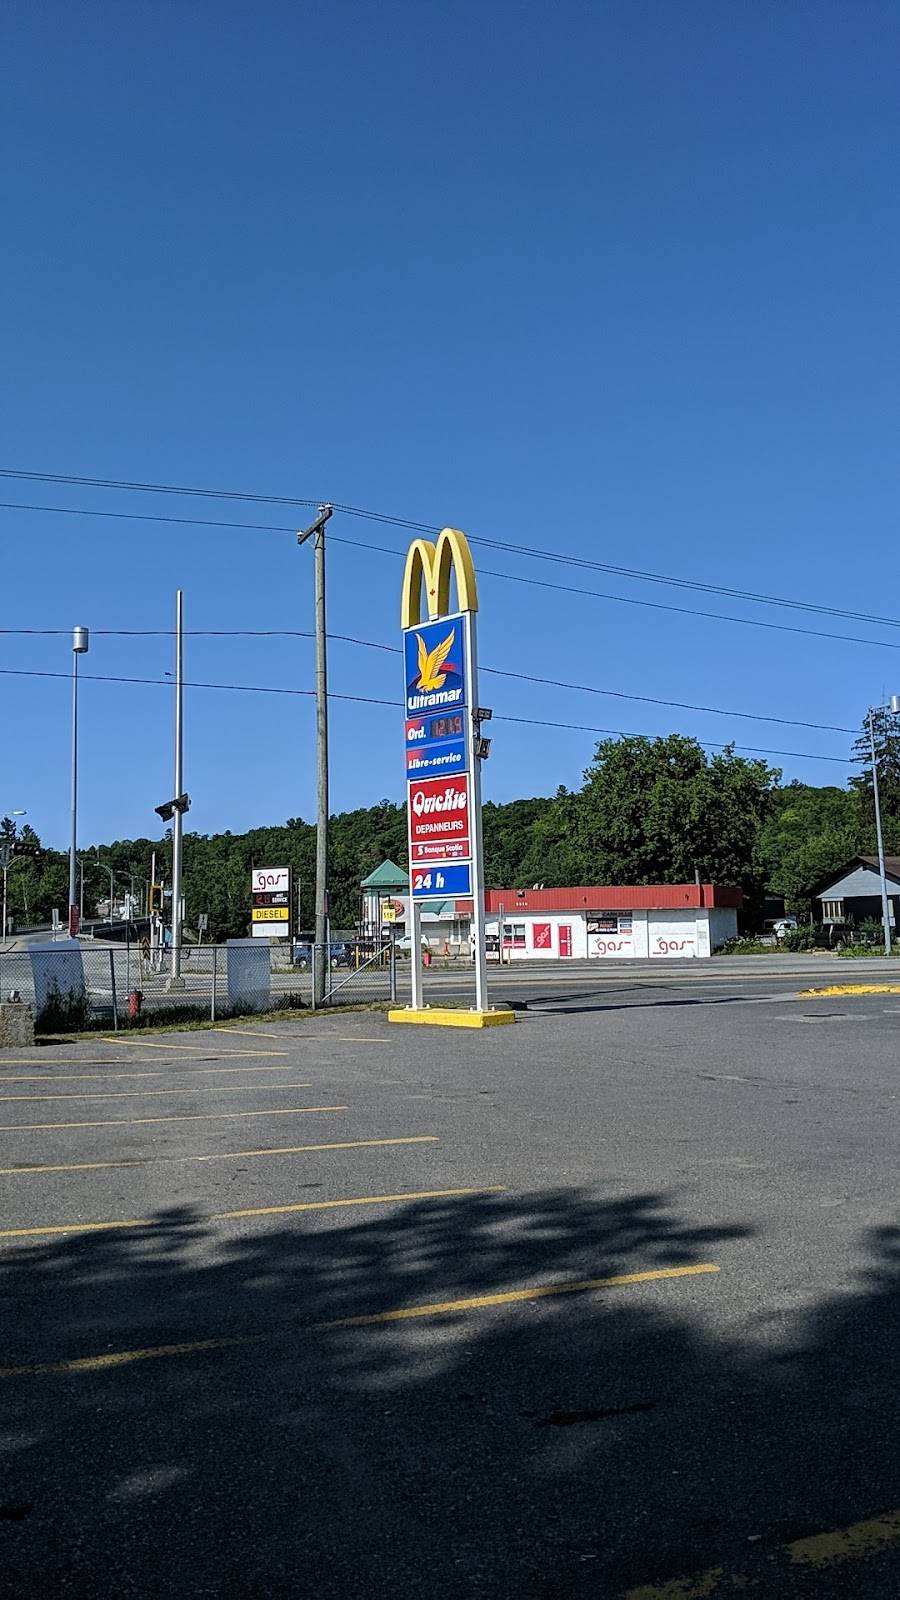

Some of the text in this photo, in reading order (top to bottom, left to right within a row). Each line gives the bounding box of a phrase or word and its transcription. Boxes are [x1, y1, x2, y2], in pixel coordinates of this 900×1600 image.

[408, 688, 462, 710] Ultramar
[407, 726, 426, 741] Ord.
[408, 752, 462, 770] Libre-service
[416, 821, 464, 834] DEPANNEURS
[424, 846, 445, 854] Banque
[445, 843, 463, 852] Scotia
[414, 872, 445, 889] 24 h
[256, 910, 284, 919] DIESEL
